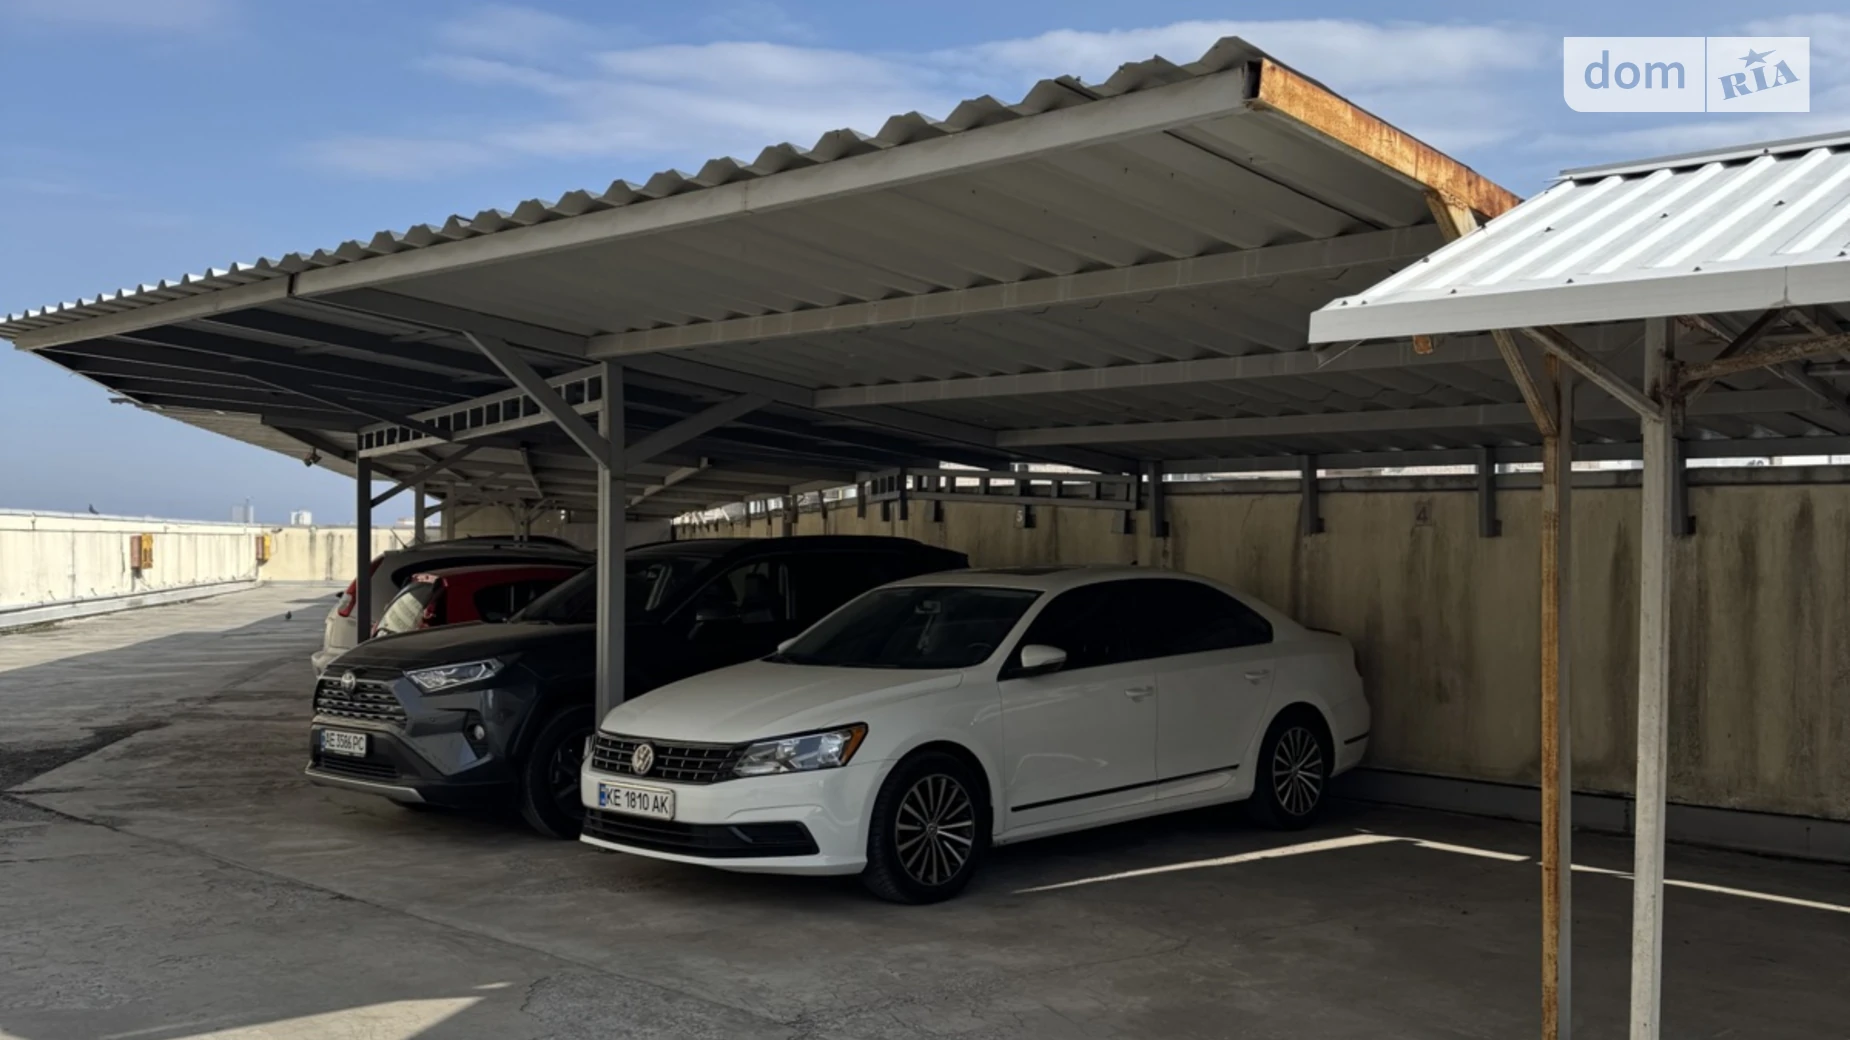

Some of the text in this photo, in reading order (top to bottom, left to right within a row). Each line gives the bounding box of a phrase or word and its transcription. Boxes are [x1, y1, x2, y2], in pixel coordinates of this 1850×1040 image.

[353, 735, 364, 751] PC
[606, 787, 669, 814] KE 1810 AK
